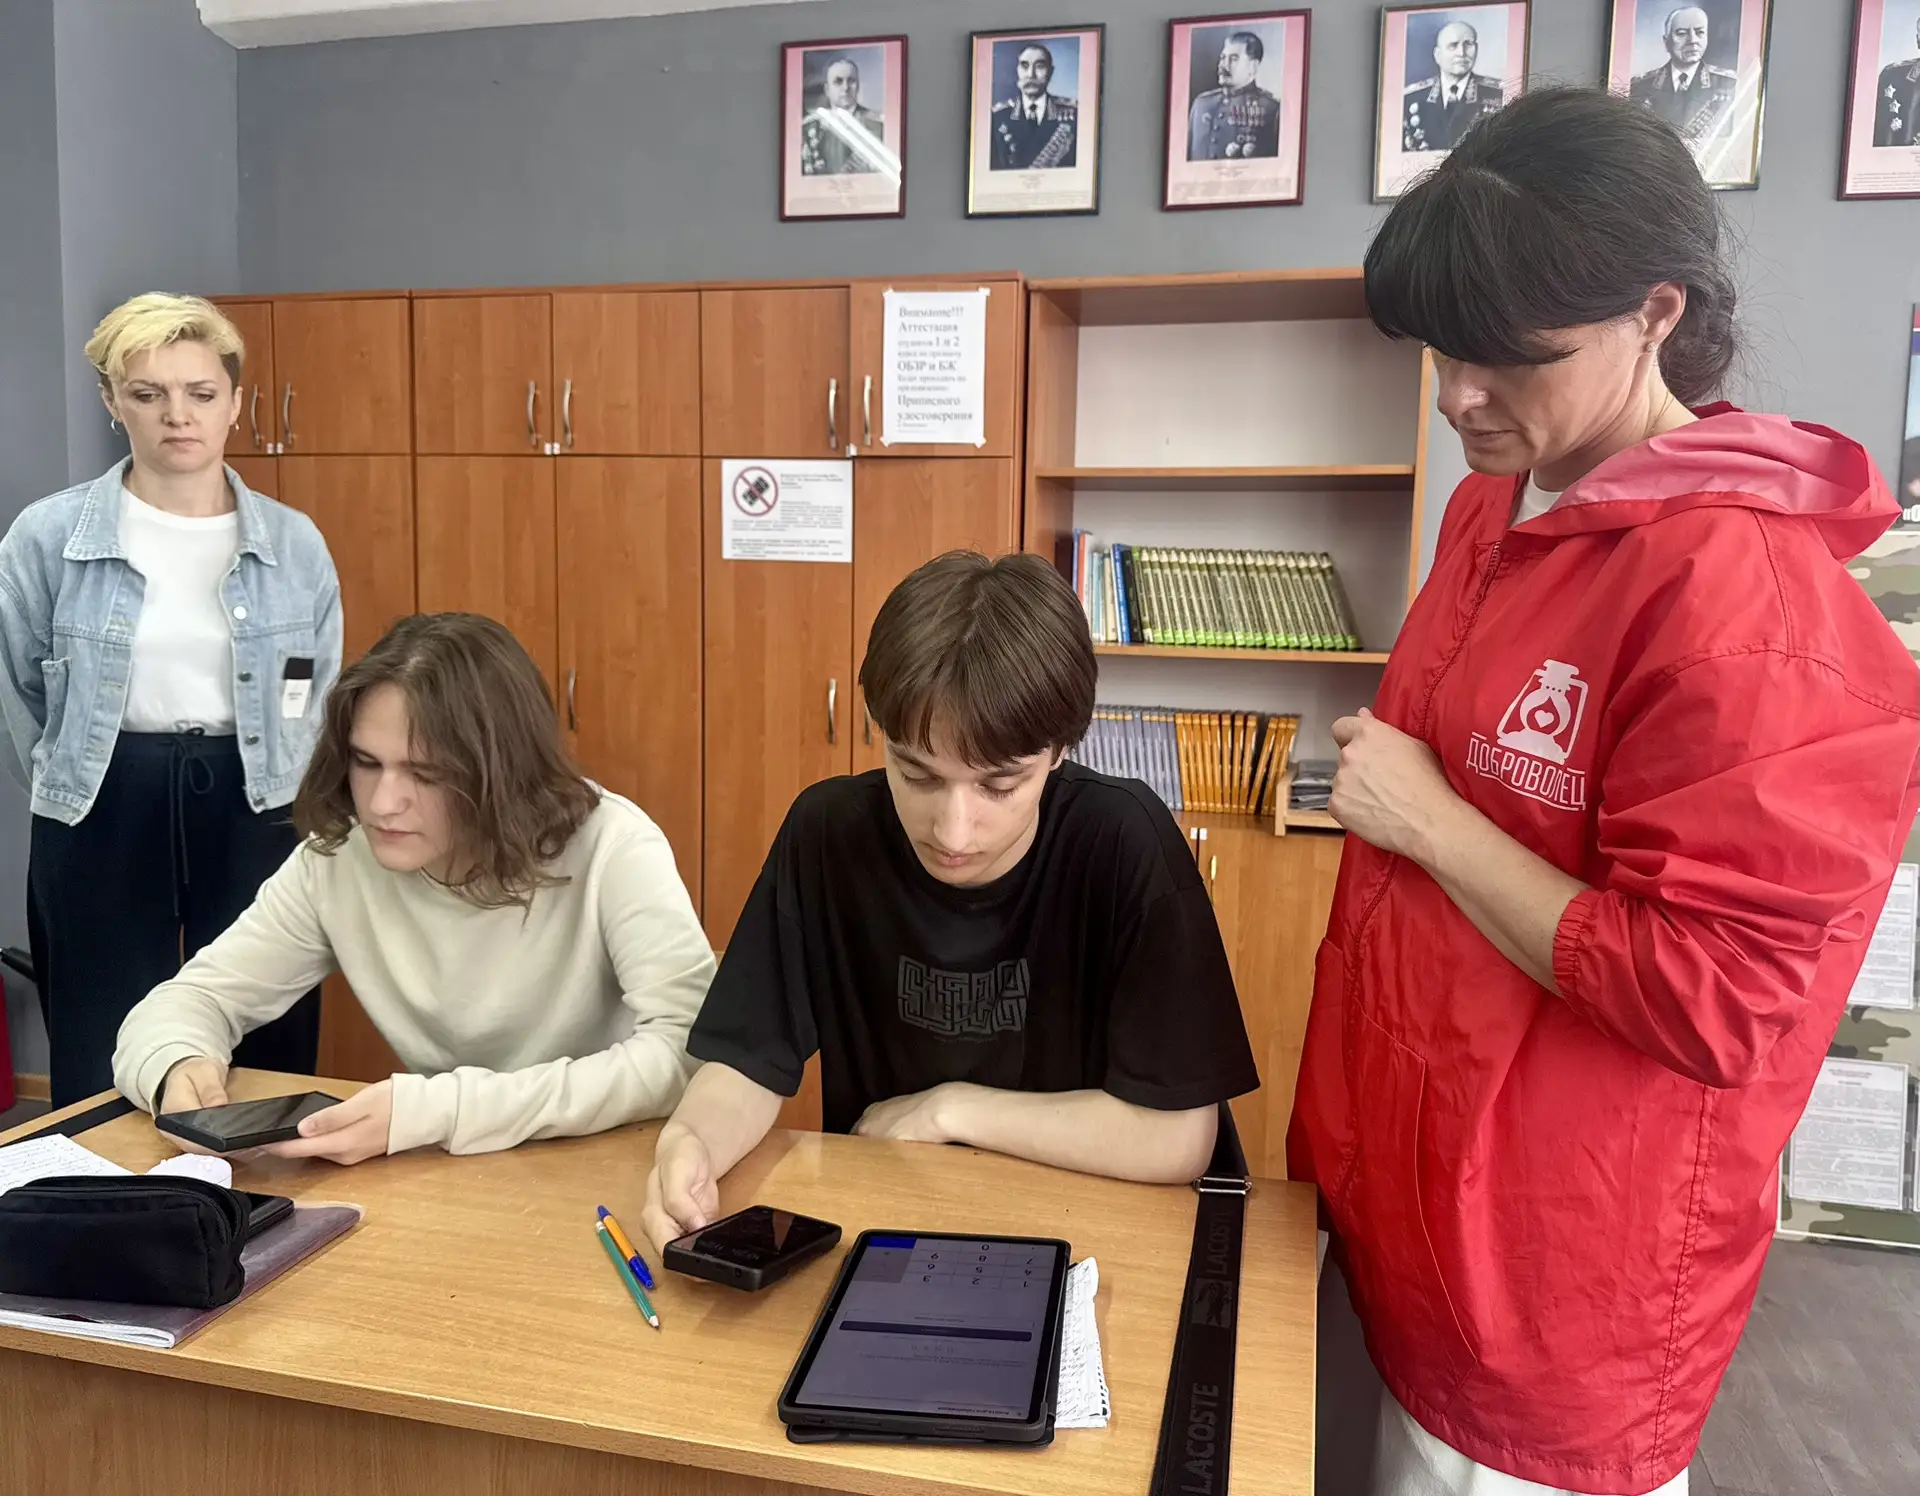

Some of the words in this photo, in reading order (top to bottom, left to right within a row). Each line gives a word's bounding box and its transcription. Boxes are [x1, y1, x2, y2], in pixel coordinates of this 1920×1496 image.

[898, 306, 964, 318] Внимание!!!
[898, 321, 958, 332] Аттестация
[935, 336, 940, 347] 1
[953, 336, 960, 347] 2
[897, 361, 927, 371] ОБЗР
[929, 363, 936, 371] и
[897, 395, 961, 408] Приписного
[897, 411, 974, 424] удостоверения
[1466, 736, 1586, 811] ДОБРОВОЛЕЦ
[930, 1252, 939, 1260] 9
[927, 1263, 936, 1271] 6
[975, 1266, 983, 1274] 5
[972, 1277, 981, 1285] 2
[1181, 1382, 1220, 1496] LACOSTE
